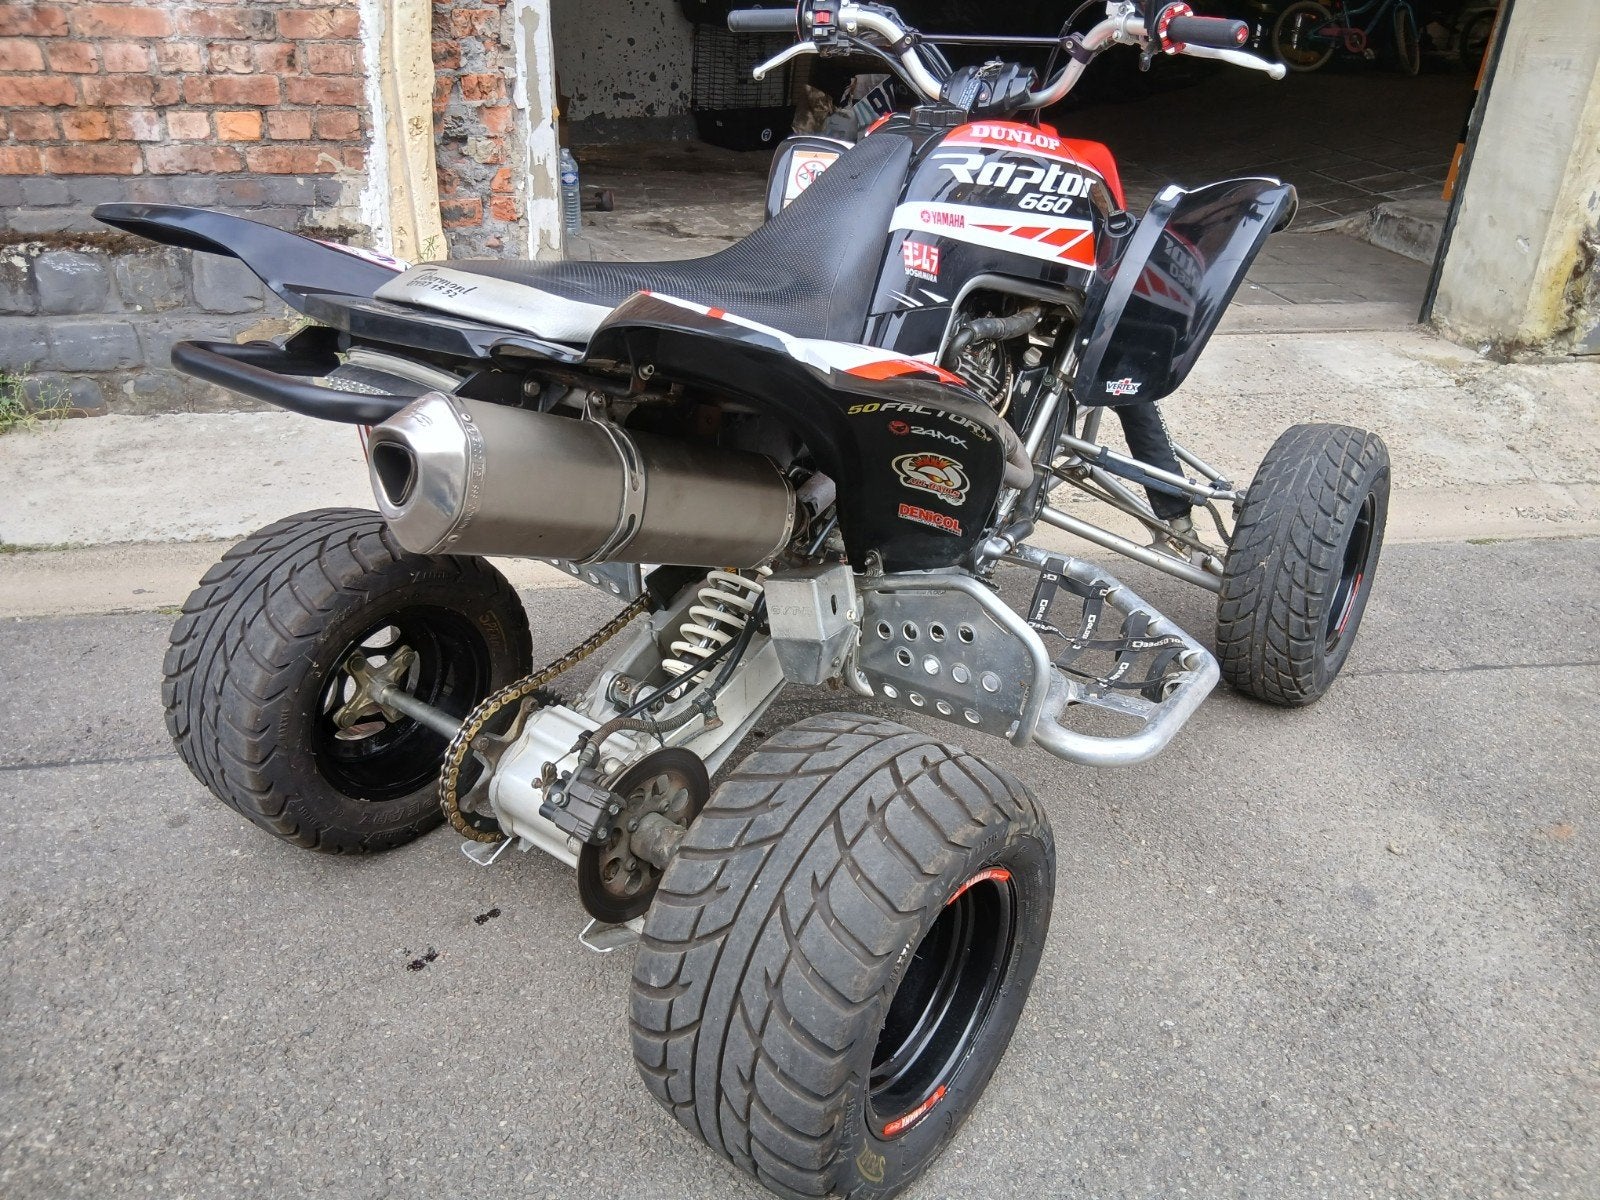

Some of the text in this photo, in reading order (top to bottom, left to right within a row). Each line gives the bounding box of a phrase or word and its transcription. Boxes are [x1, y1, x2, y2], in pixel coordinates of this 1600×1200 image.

[970, 125, 1060, 151] DUNLOP
[931, 153, 1097, 199] Raptor
[1018, 193, 1073, 214] 660
[931, 210, 965, 229] YAMAHA
[903, 240, 939, 275] ヨシムラ
[1106, 382, 1138, 391] VERTEX
[909, 425, 969, 450] 24MX
